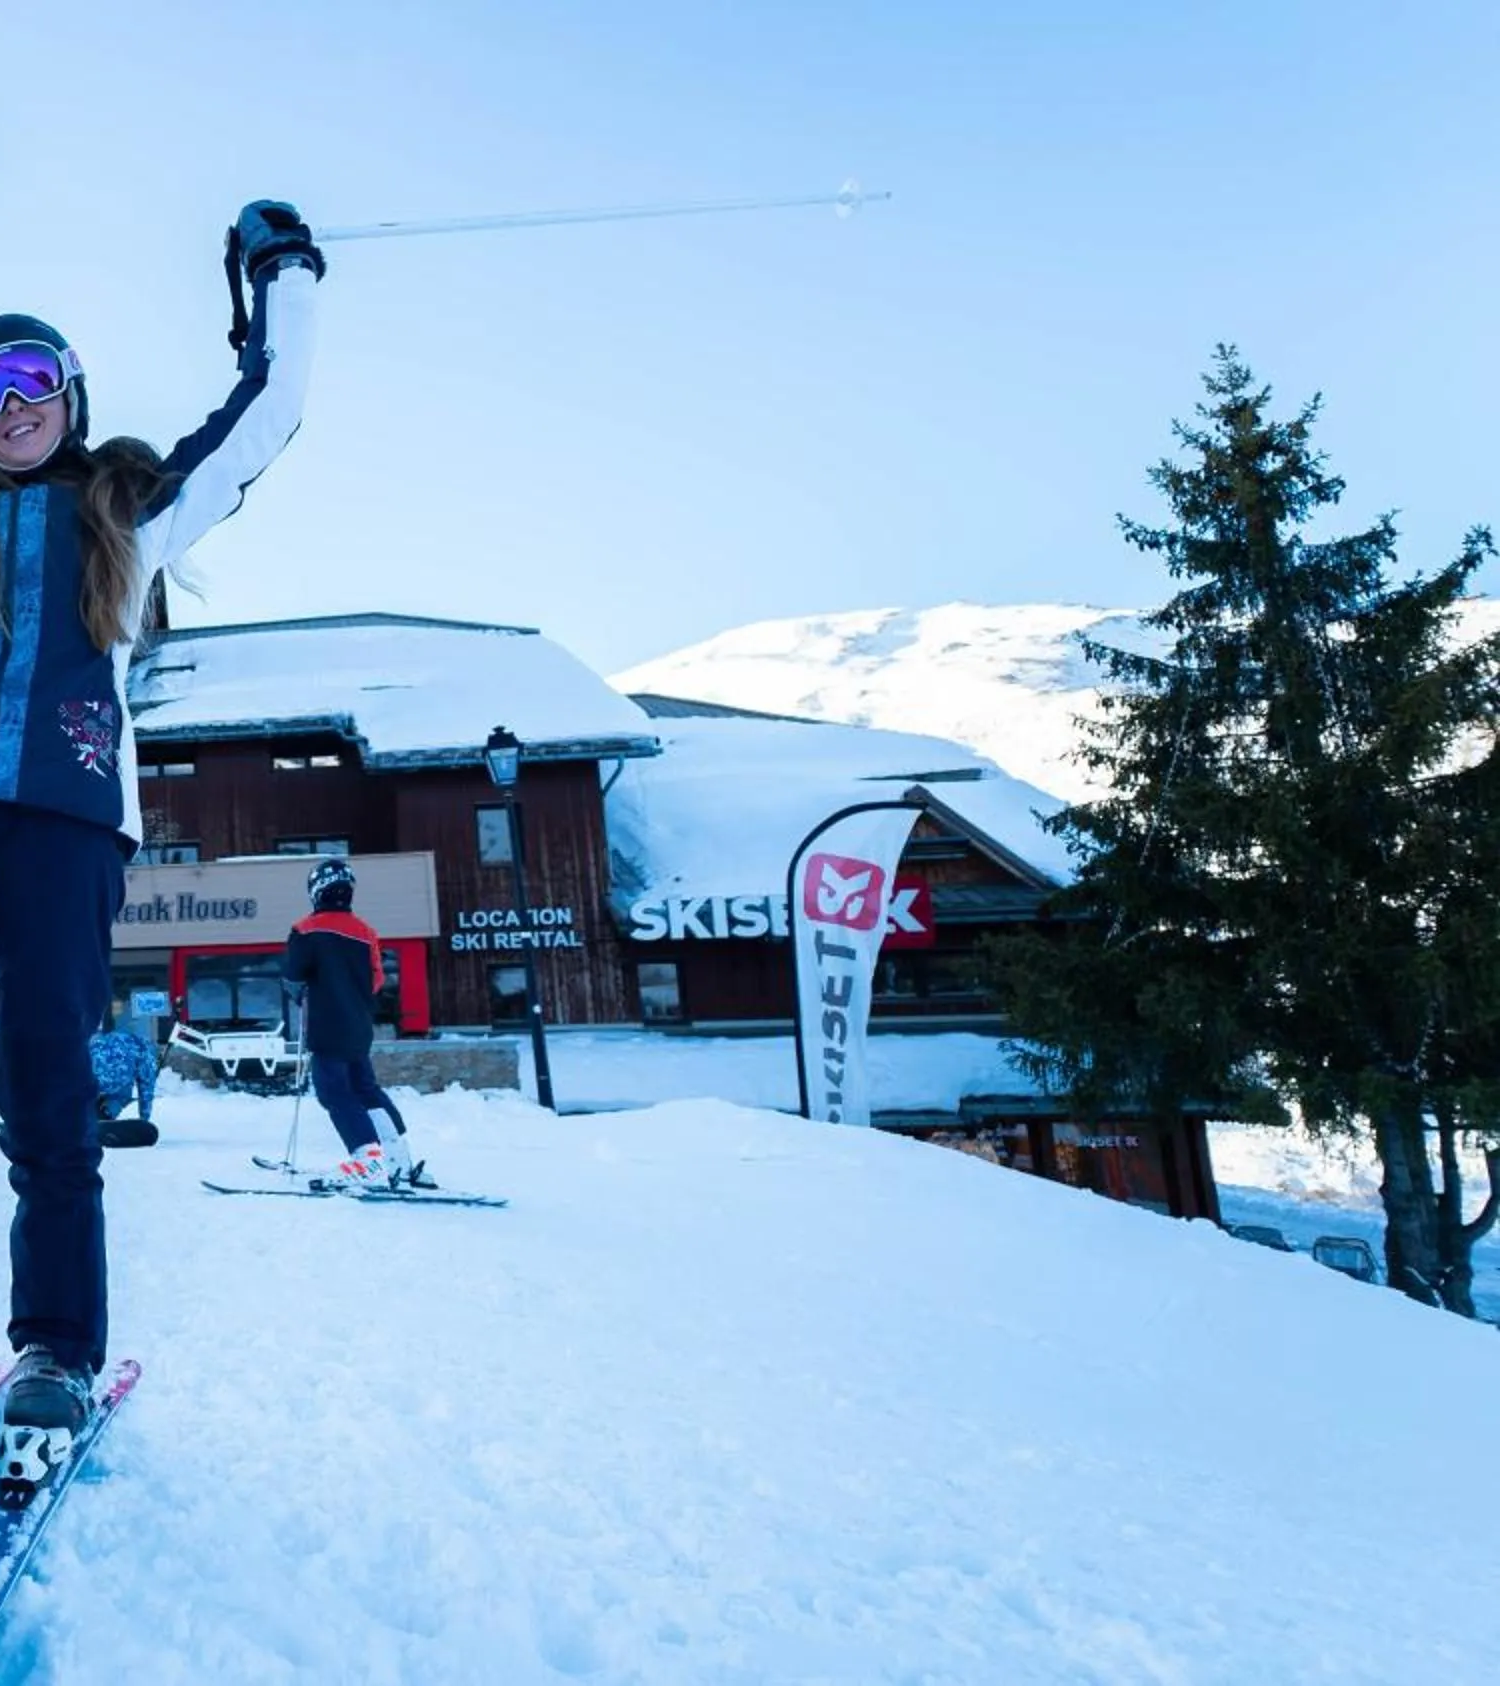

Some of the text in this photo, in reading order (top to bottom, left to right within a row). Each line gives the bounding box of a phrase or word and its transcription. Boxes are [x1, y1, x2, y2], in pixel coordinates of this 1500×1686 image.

[115, 891, 257, 924] eak House
[629, 895, 790, 941] SKISE
[451, 932, 488, 951] SKI
